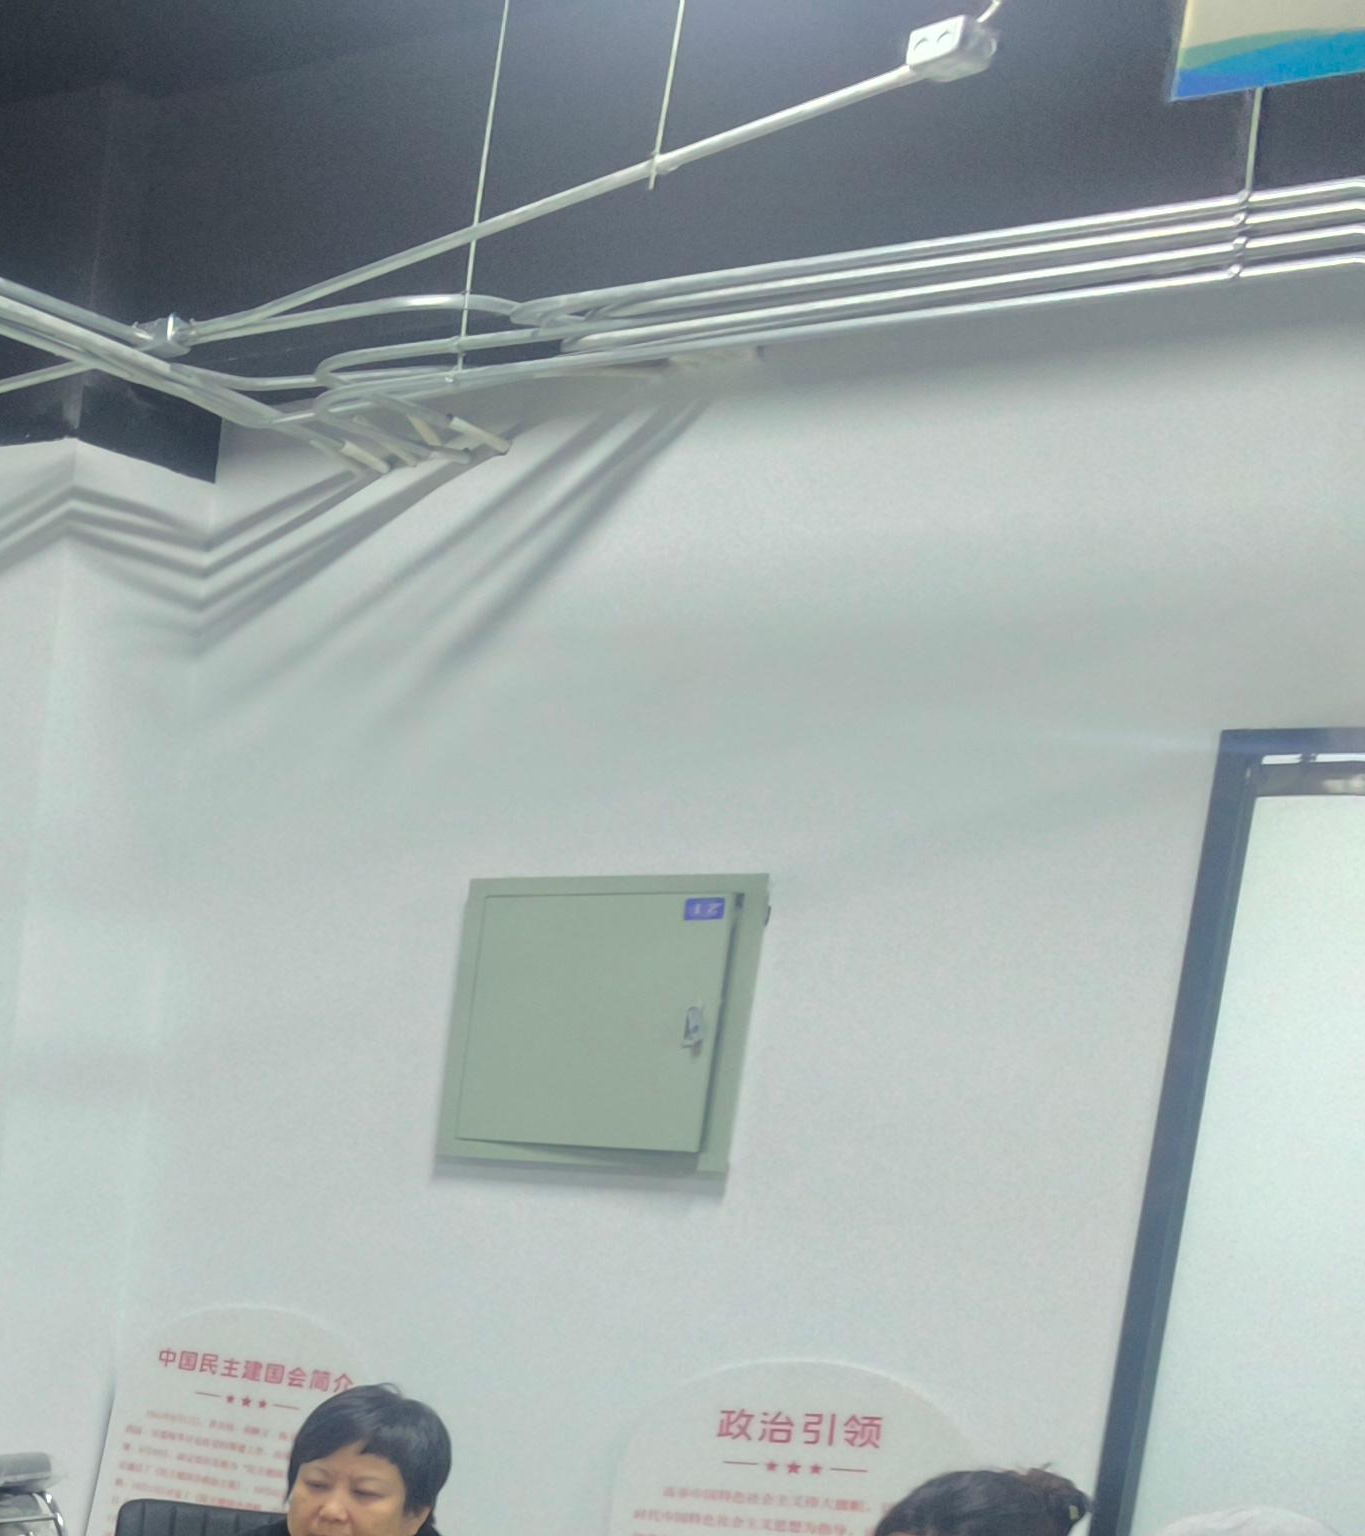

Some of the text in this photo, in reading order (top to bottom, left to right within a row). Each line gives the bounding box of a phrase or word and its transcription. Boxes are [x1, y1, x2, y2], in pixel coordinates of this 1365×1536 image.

[157, 1348, 355, 1394] 中国民主建国会简介
[716, 1408, 884, 1449] 政治引领
